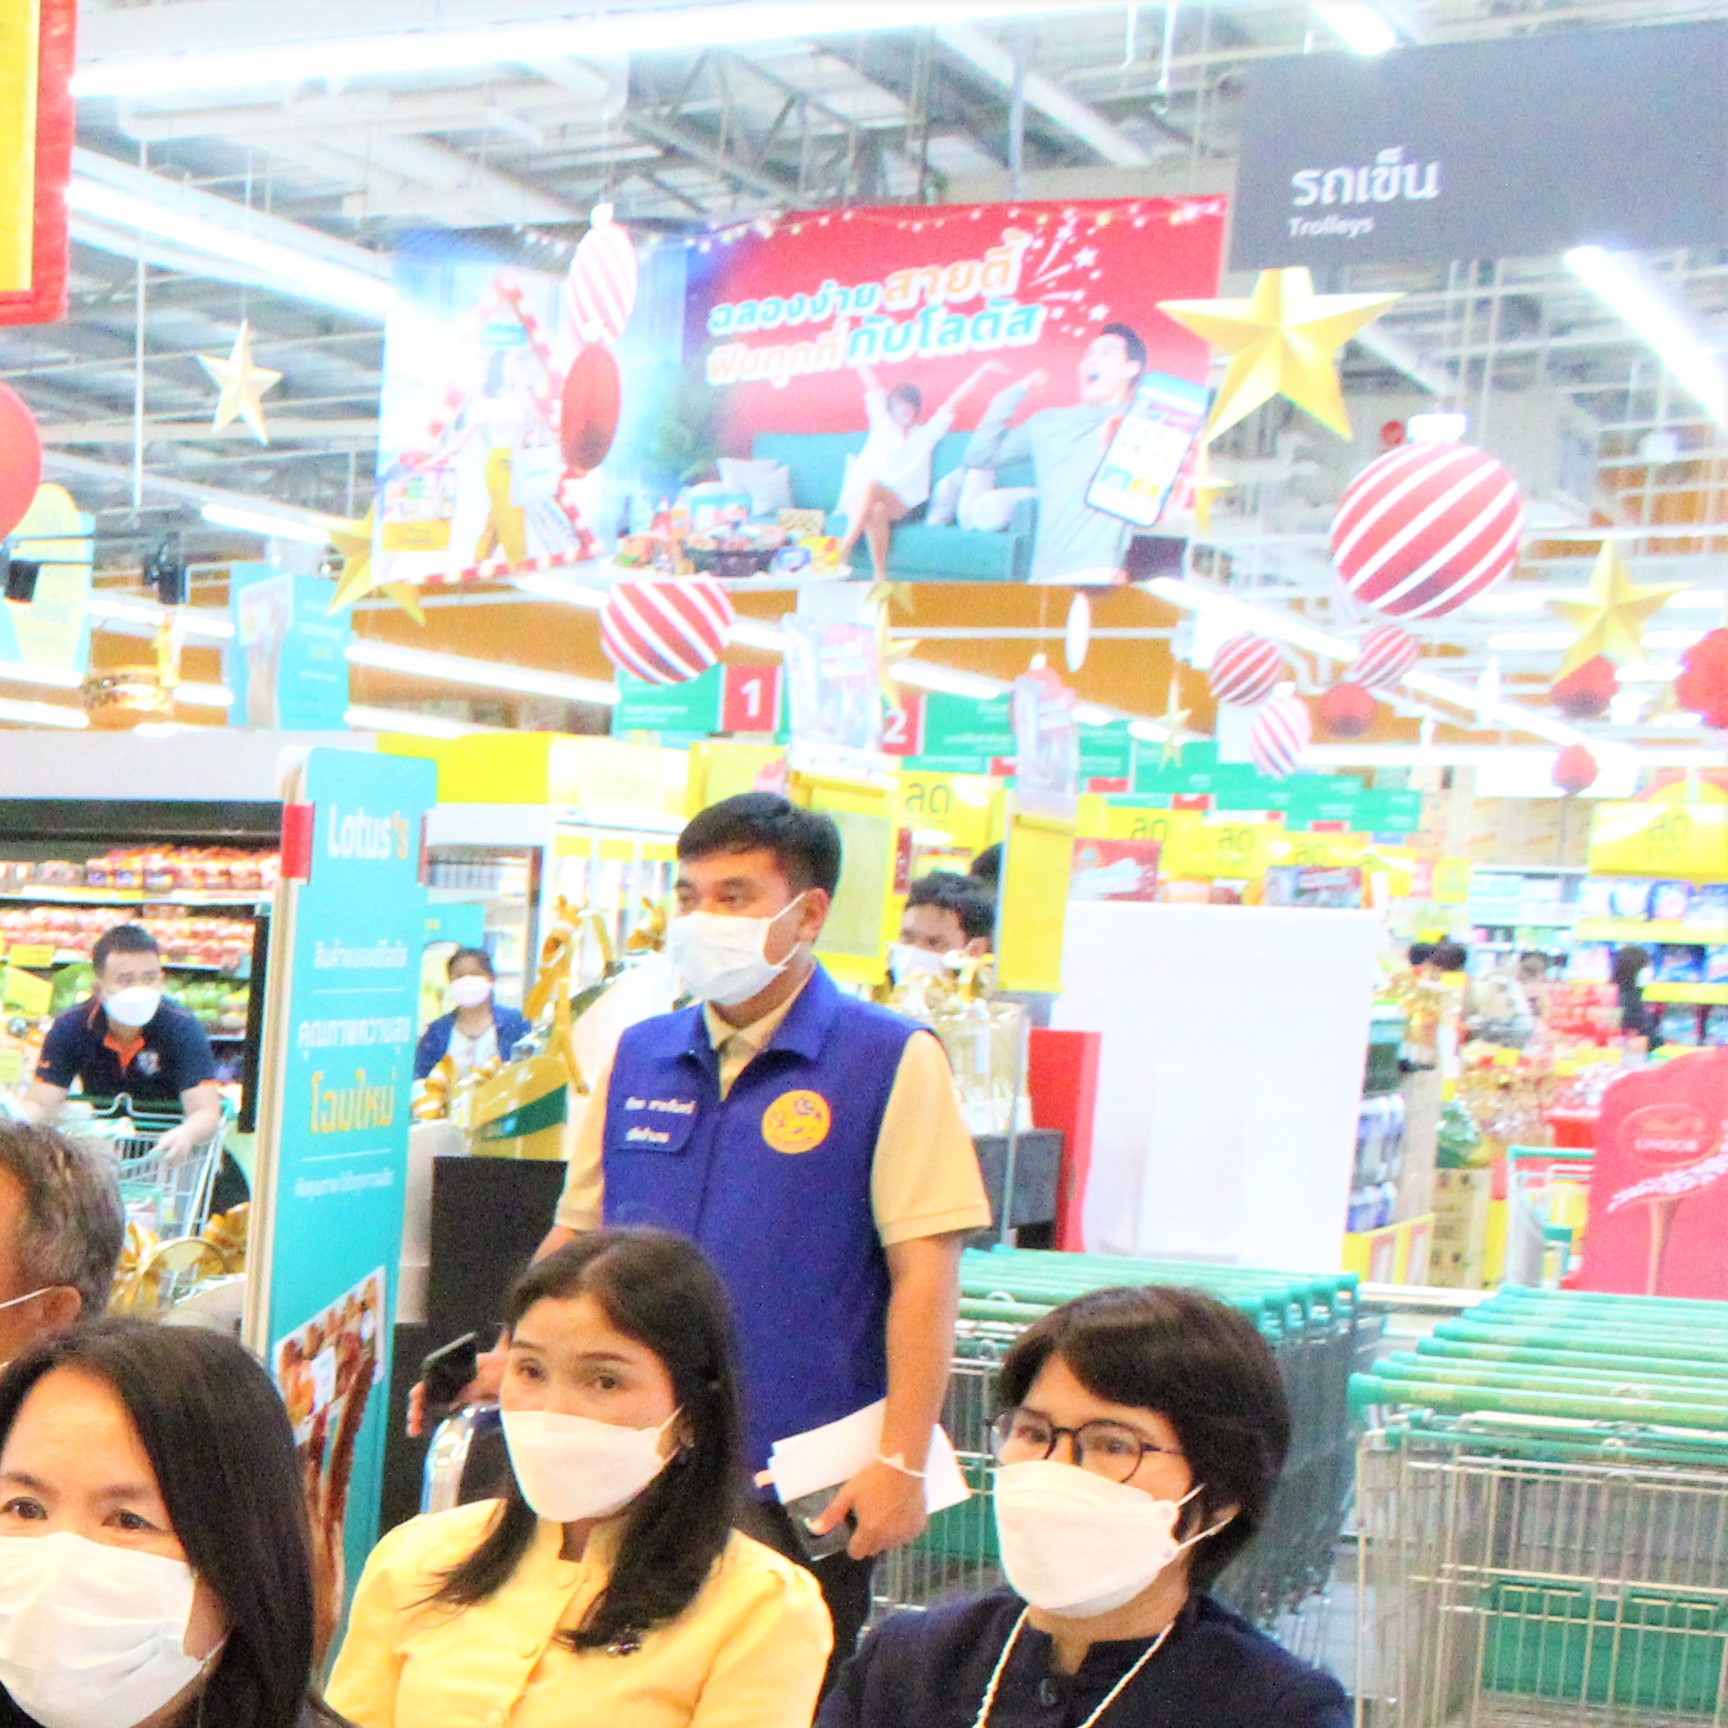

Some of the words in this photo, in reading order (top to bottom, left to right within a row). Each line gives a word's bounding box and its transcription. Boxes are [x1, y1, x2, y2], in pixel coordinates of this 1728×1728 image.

[1290, 145, 1441, 207] รถเข็น
[1288, 214, 1375, 239] Trolleys
[740, 678, 762, 718] 1
[882, 709, 908, 745] 2
[327, 803, 409, 861] Lotus's
